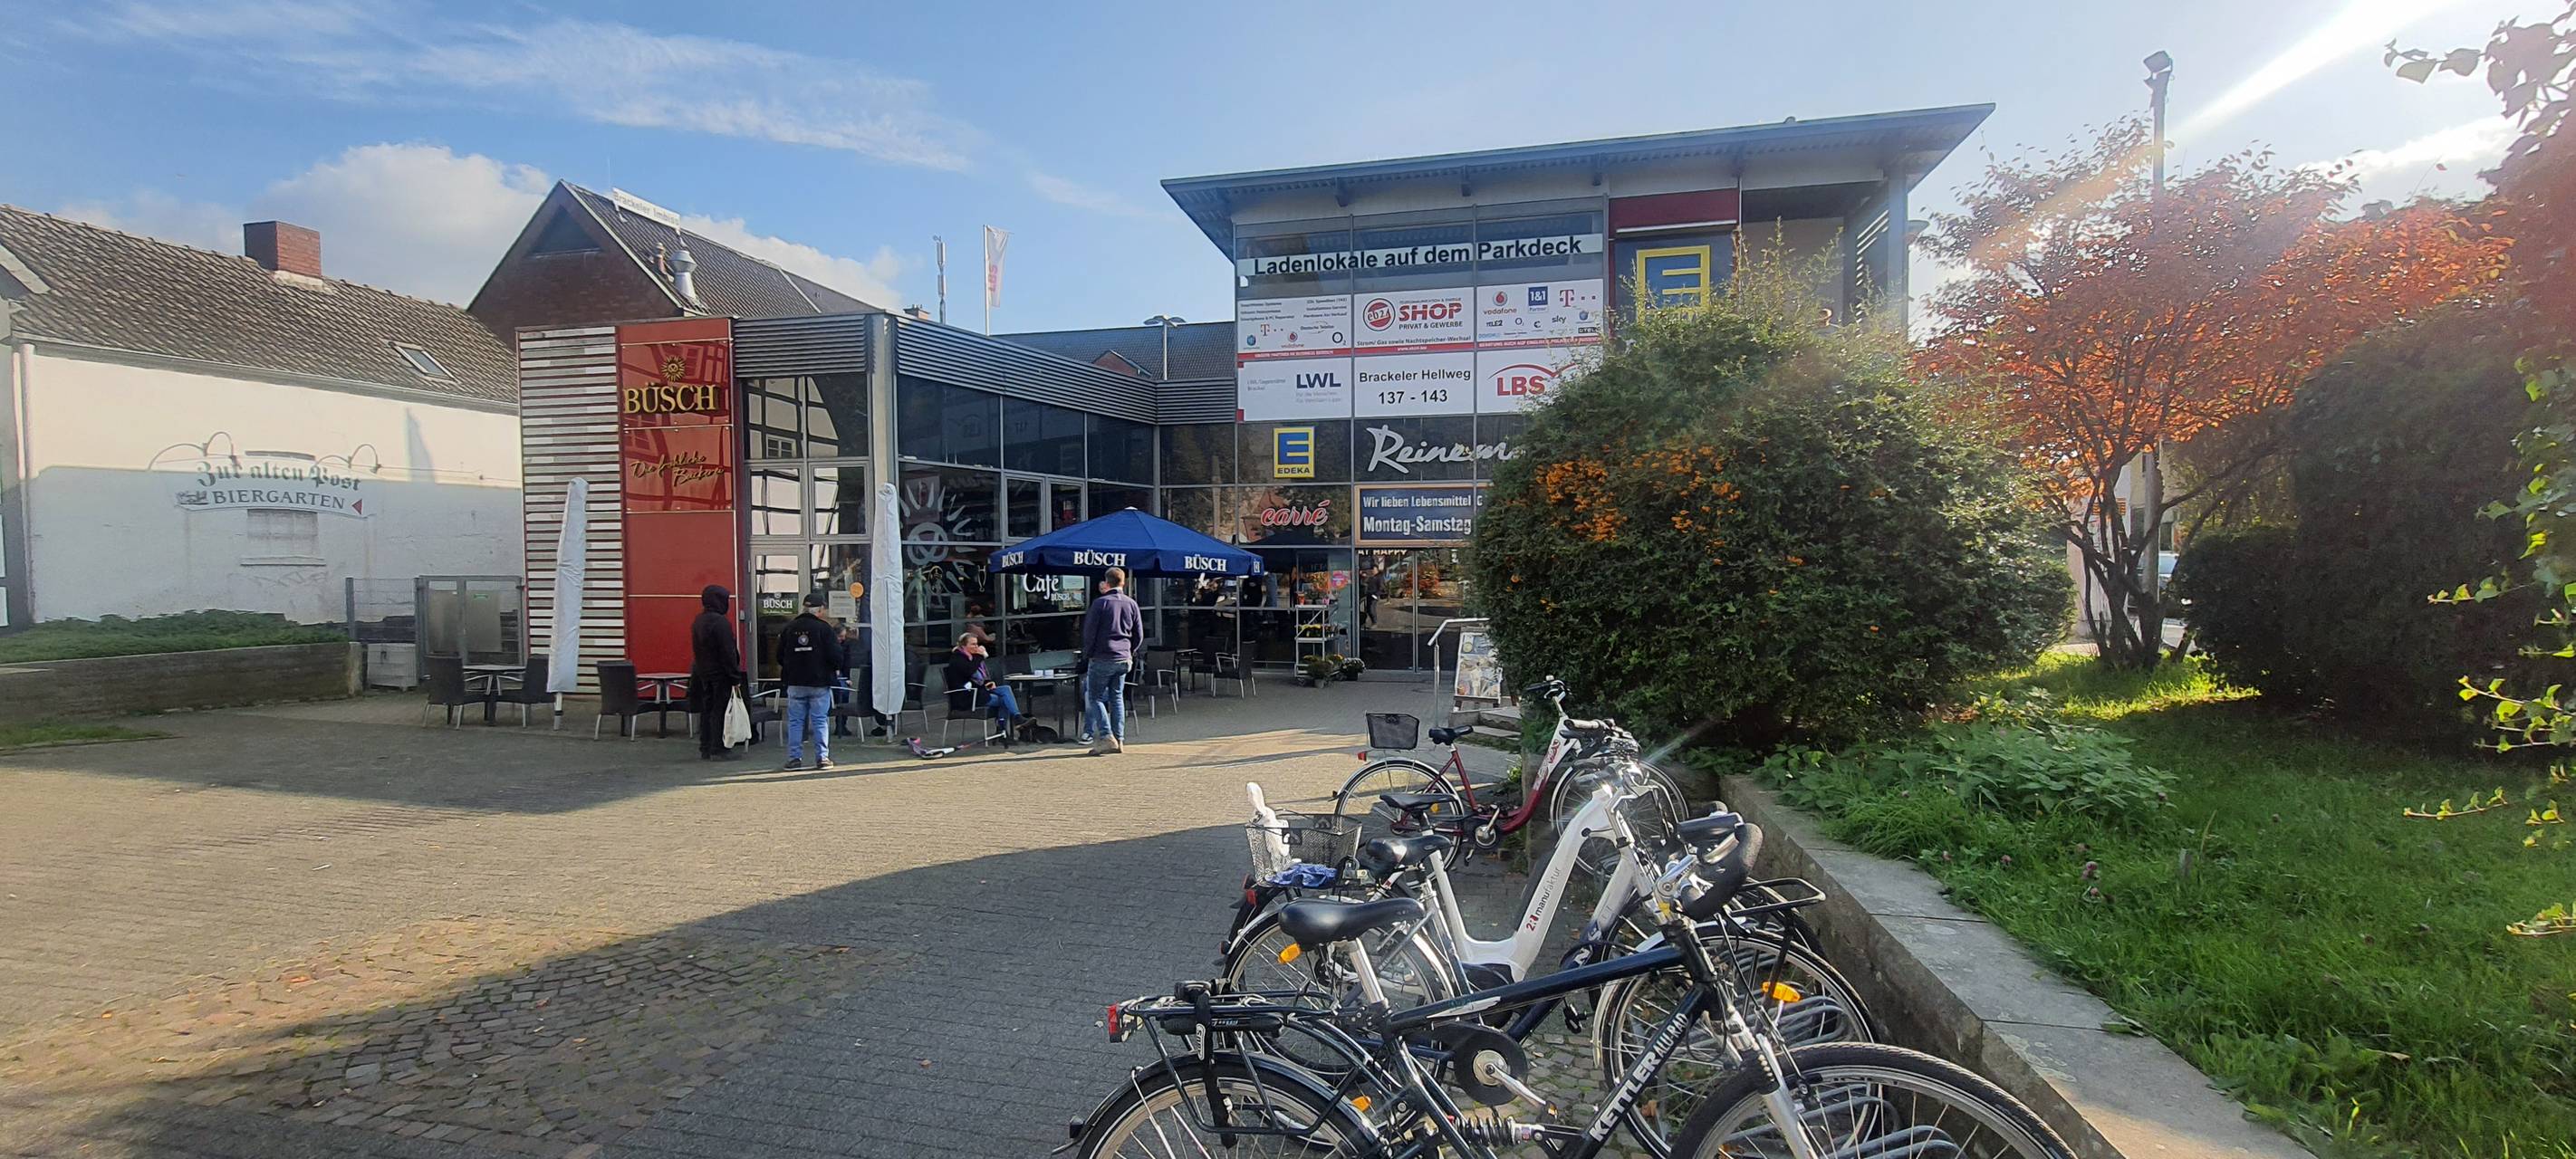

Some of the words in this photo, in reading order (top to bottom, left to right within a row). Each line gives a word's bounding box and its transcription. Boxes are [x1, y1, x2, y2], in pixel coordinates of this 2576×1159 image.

[1254, 251, 1378, 275] Ladenlokale
[1385, 246, 1418, 267] auf
[1425, 244, 1470, 264] dem
[1478, 235, 1581, 260] Parkdeck
[1530, 291, 1546, 302] 1&1
[1399, 302, 1462, 321] SHOP
[1552, 315, 1567, 324] sky
[1296, 372, 1341, 388] LWL
[1360, 369, 1418, 382] Brackeler
[1422, 369, 1471, 381] Hellweg
[1497, 375, 1544, 396] LBS
[623, 382, 716, 414] BÜSCH
[1379, 391, 1405, 405] 137
[1421, 389, 1447, 403] 143
[1366, 424, 1525, 474] Reinem
[197, 461, 240, 487] Zur
[250, 462, 303, 482] alten
[311, 464, 361, 492] Post
[212, 490, 345, 510] BIERGARTEN
[1363, 495, 1380, 508] Wir
[1381, 495, 1408, 507] lieben
[1411, 494, 1471, 507] Lebensmittel
[1261, 499, 1331, 526] carré
[1363, 516, 1472, 535] Montag-Samstag
[1002, 551, 1024, 568] BÜSCH
[1073, 550, 1127, 567] BÜSCH
[1184, 553, 1227, 571] BÜSCH
[1023, 573, 1059, 599] Café
[763, 598, 793, 608] BÜSCH
[1590, 1051, 1660, 1142] KETTLER
[1653, 1013, 1689, 1058] ALU-RAD
